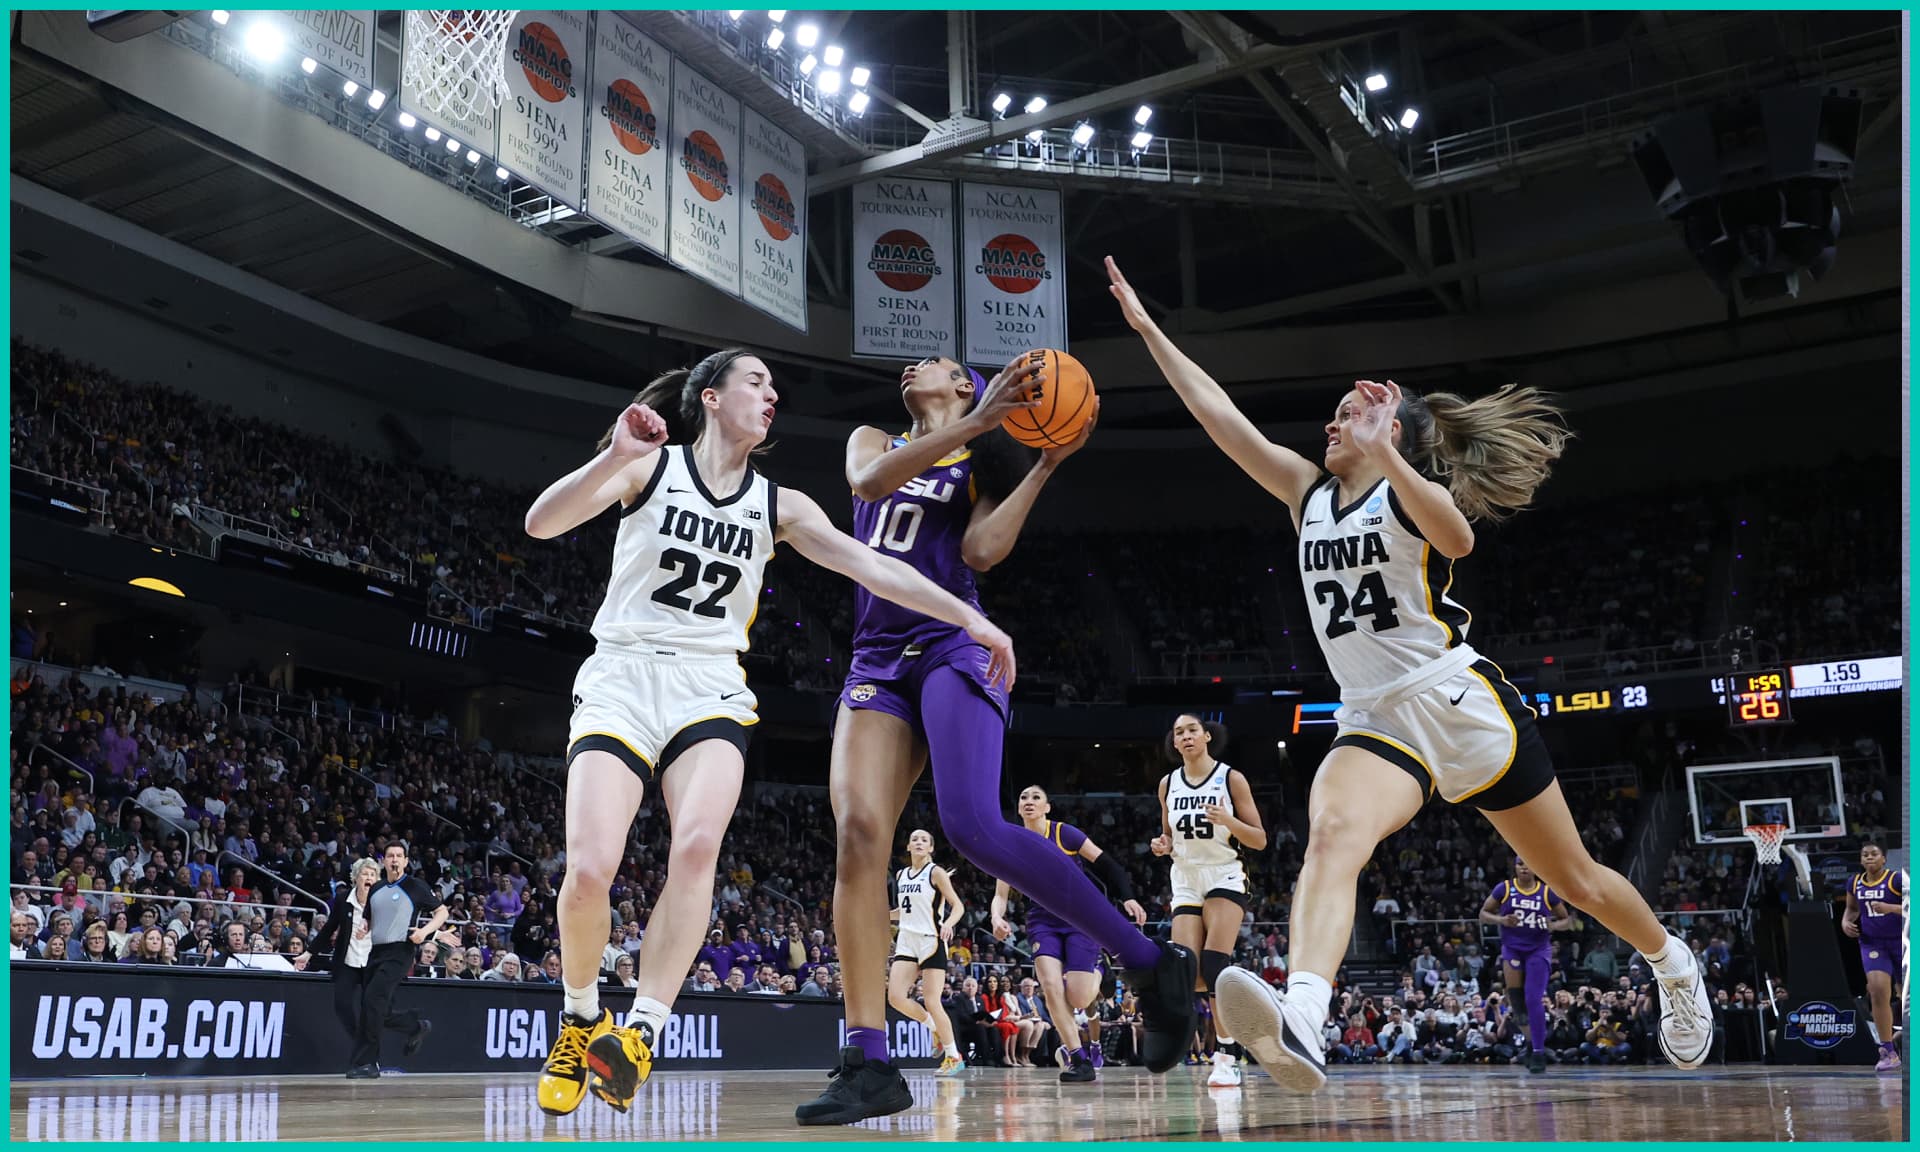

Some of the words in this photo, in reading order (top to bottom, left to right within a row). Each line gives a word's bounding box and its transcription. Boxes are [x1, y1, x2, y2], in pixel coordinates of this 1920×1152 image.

[519, 28, 572, 78] MAAC
[614, 24, 653, 64] NCAA
[316, 42, 335, 60] OF
[340, 55, 366, 79] 1973
[512, 49, 576, 98] CHAMPIONS
[601, 34, 665, 87] TOURNAMENT
[607, 85, 656, 131] MAAC
[690, 76, 725, 115] NCAA
[440, 110, 476, 137] Regional
[516, 95, 567, 141] SIENA
[677, 89, 736, 135] TOURNAMENT
[526, 122, 559, 154] 1999
[601, 105, 660, 150] CHAMPIONS
[760, 123, 791, 158] NCAA
[508, 133, 535, 157] FIRST
[538, 151, 574, 181] ROUND
[604, 148, 652, 191] SIENA
[684, 137, 728, 178] MAAC
[535, 164, 567, 191] Regional
[612, 174, 644, 206] 2002
[680, 156, 733, 196] CHAMPIONS
[755, 181, 795, 218] MAAC
[877, 183, 928, 201] NCAA
[986, 191, 1038, 210] NCAA
[597, 185, 621, 208] FIRST
[624, 201, 659, 229] ROUND
[683, 198, 727, 235] SIENA
[751, 200, 800, 236] CHAMPIONS
[860, 202, 945, 219] TOURNAMENT
[969, 207, 1056, 225] TOURNAMENT
[690, 222, 720, 250] 2008
[673, 230, 705, 256] SECOND
[707, 248, 738, 273] ROUND
[754, 238, 795, 274] SIENA
[873, 244, 935, 262] MAAC
[982, 247, 1046, 268] MAAC
[761, 260, 789, 287] 2009
[867, 260, 942, 276] CHAMPIONS
[975, 265, 1053, 280] CHAMPIONS
[878, 297, 930, 312] SIENA
[984, 300, 1045, 319] SIENA
[862, 326, 897, 338] FIRST
[902, 328, 948, 341] ROUND
[888, 313, 921, 326] 2010
[995, 321, 1036, 334] 2020
[869, 340, 896, 349] South
[900, 341, 940, 352] Regional
[1000, 335, 1032, 347] NCAA
[897, 477, 956, 502] SU
[659, 505, 753, 560] IOWA
[867, 499, 925, 553] 10
[1304, 532, 1390, 572] IOWA
[651, 547, 742, 619] 22
[1314, 571, 1400, 640] 24
[1749, 674, 1781, 691] 1:59
[1822, 663, 1861, 683] 1:59
[1540, 703, 1549, 716] 3
[1555, 691, 1611, 712] LSU
[1622, 686, 1648, 708] 23
[1790, 685, 1838, 698] BASKETBALL
[1839, 679, 1902, 694] CHAMPIONSHIP
[1741, 691, 1780, 720] 26
[1174, 796, 1217, 811] IOWA
[1176, 814, 1214, 839] 45
[901, 896, 911, 913] 4
[1511, 898, 1541, 910] LSU
[1857, 889, 1884, 899] LSU
[1514, 910, 1536, 928] 24
[32, 995, 286, 1058] USAB.COM
[485, 1008, 547, 1058] USA
[1800, 1013, 1836, 1024] MARCH
[1805, 1023, 1854, 1033] MADNESS
